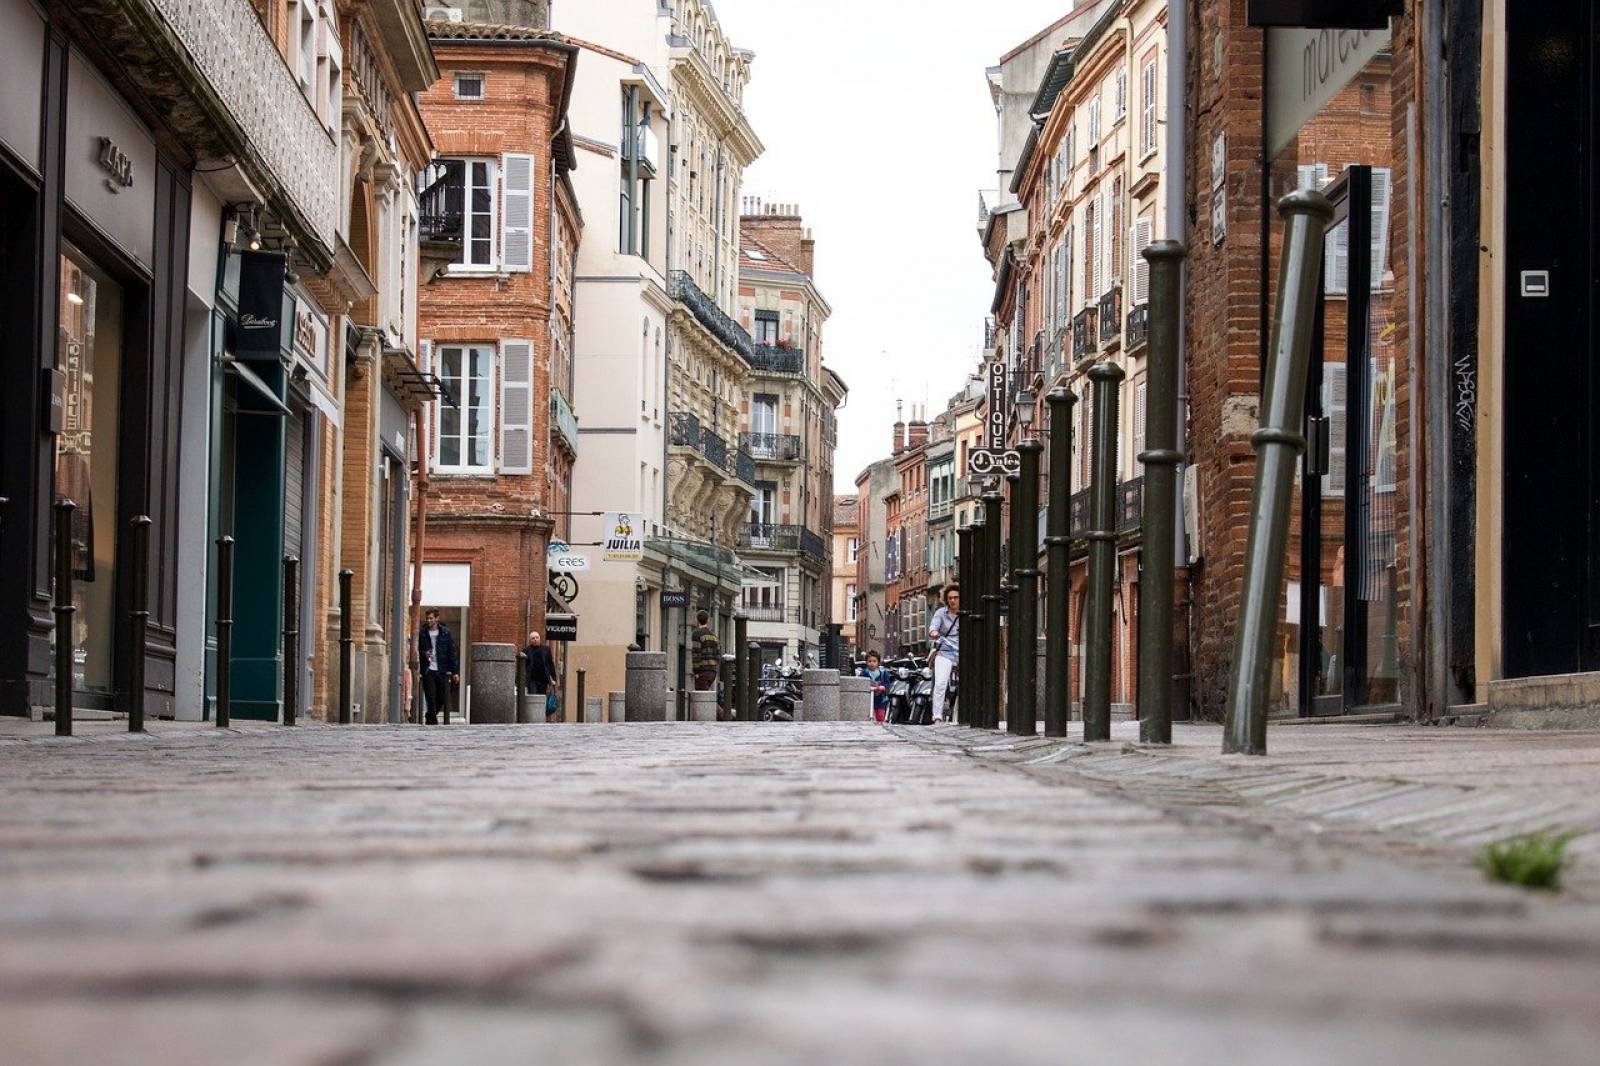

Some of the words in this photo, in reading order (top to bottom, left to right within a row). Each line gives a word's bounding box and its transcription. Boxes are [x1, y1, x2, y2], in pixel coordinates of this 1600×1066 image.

[992, 363, 1004, 450] OPTIQUE
[606, 539, 641, 551] JUILIA
[558, 557, 585, 567] ERES
[663, 594, 686, 603] BOSS
